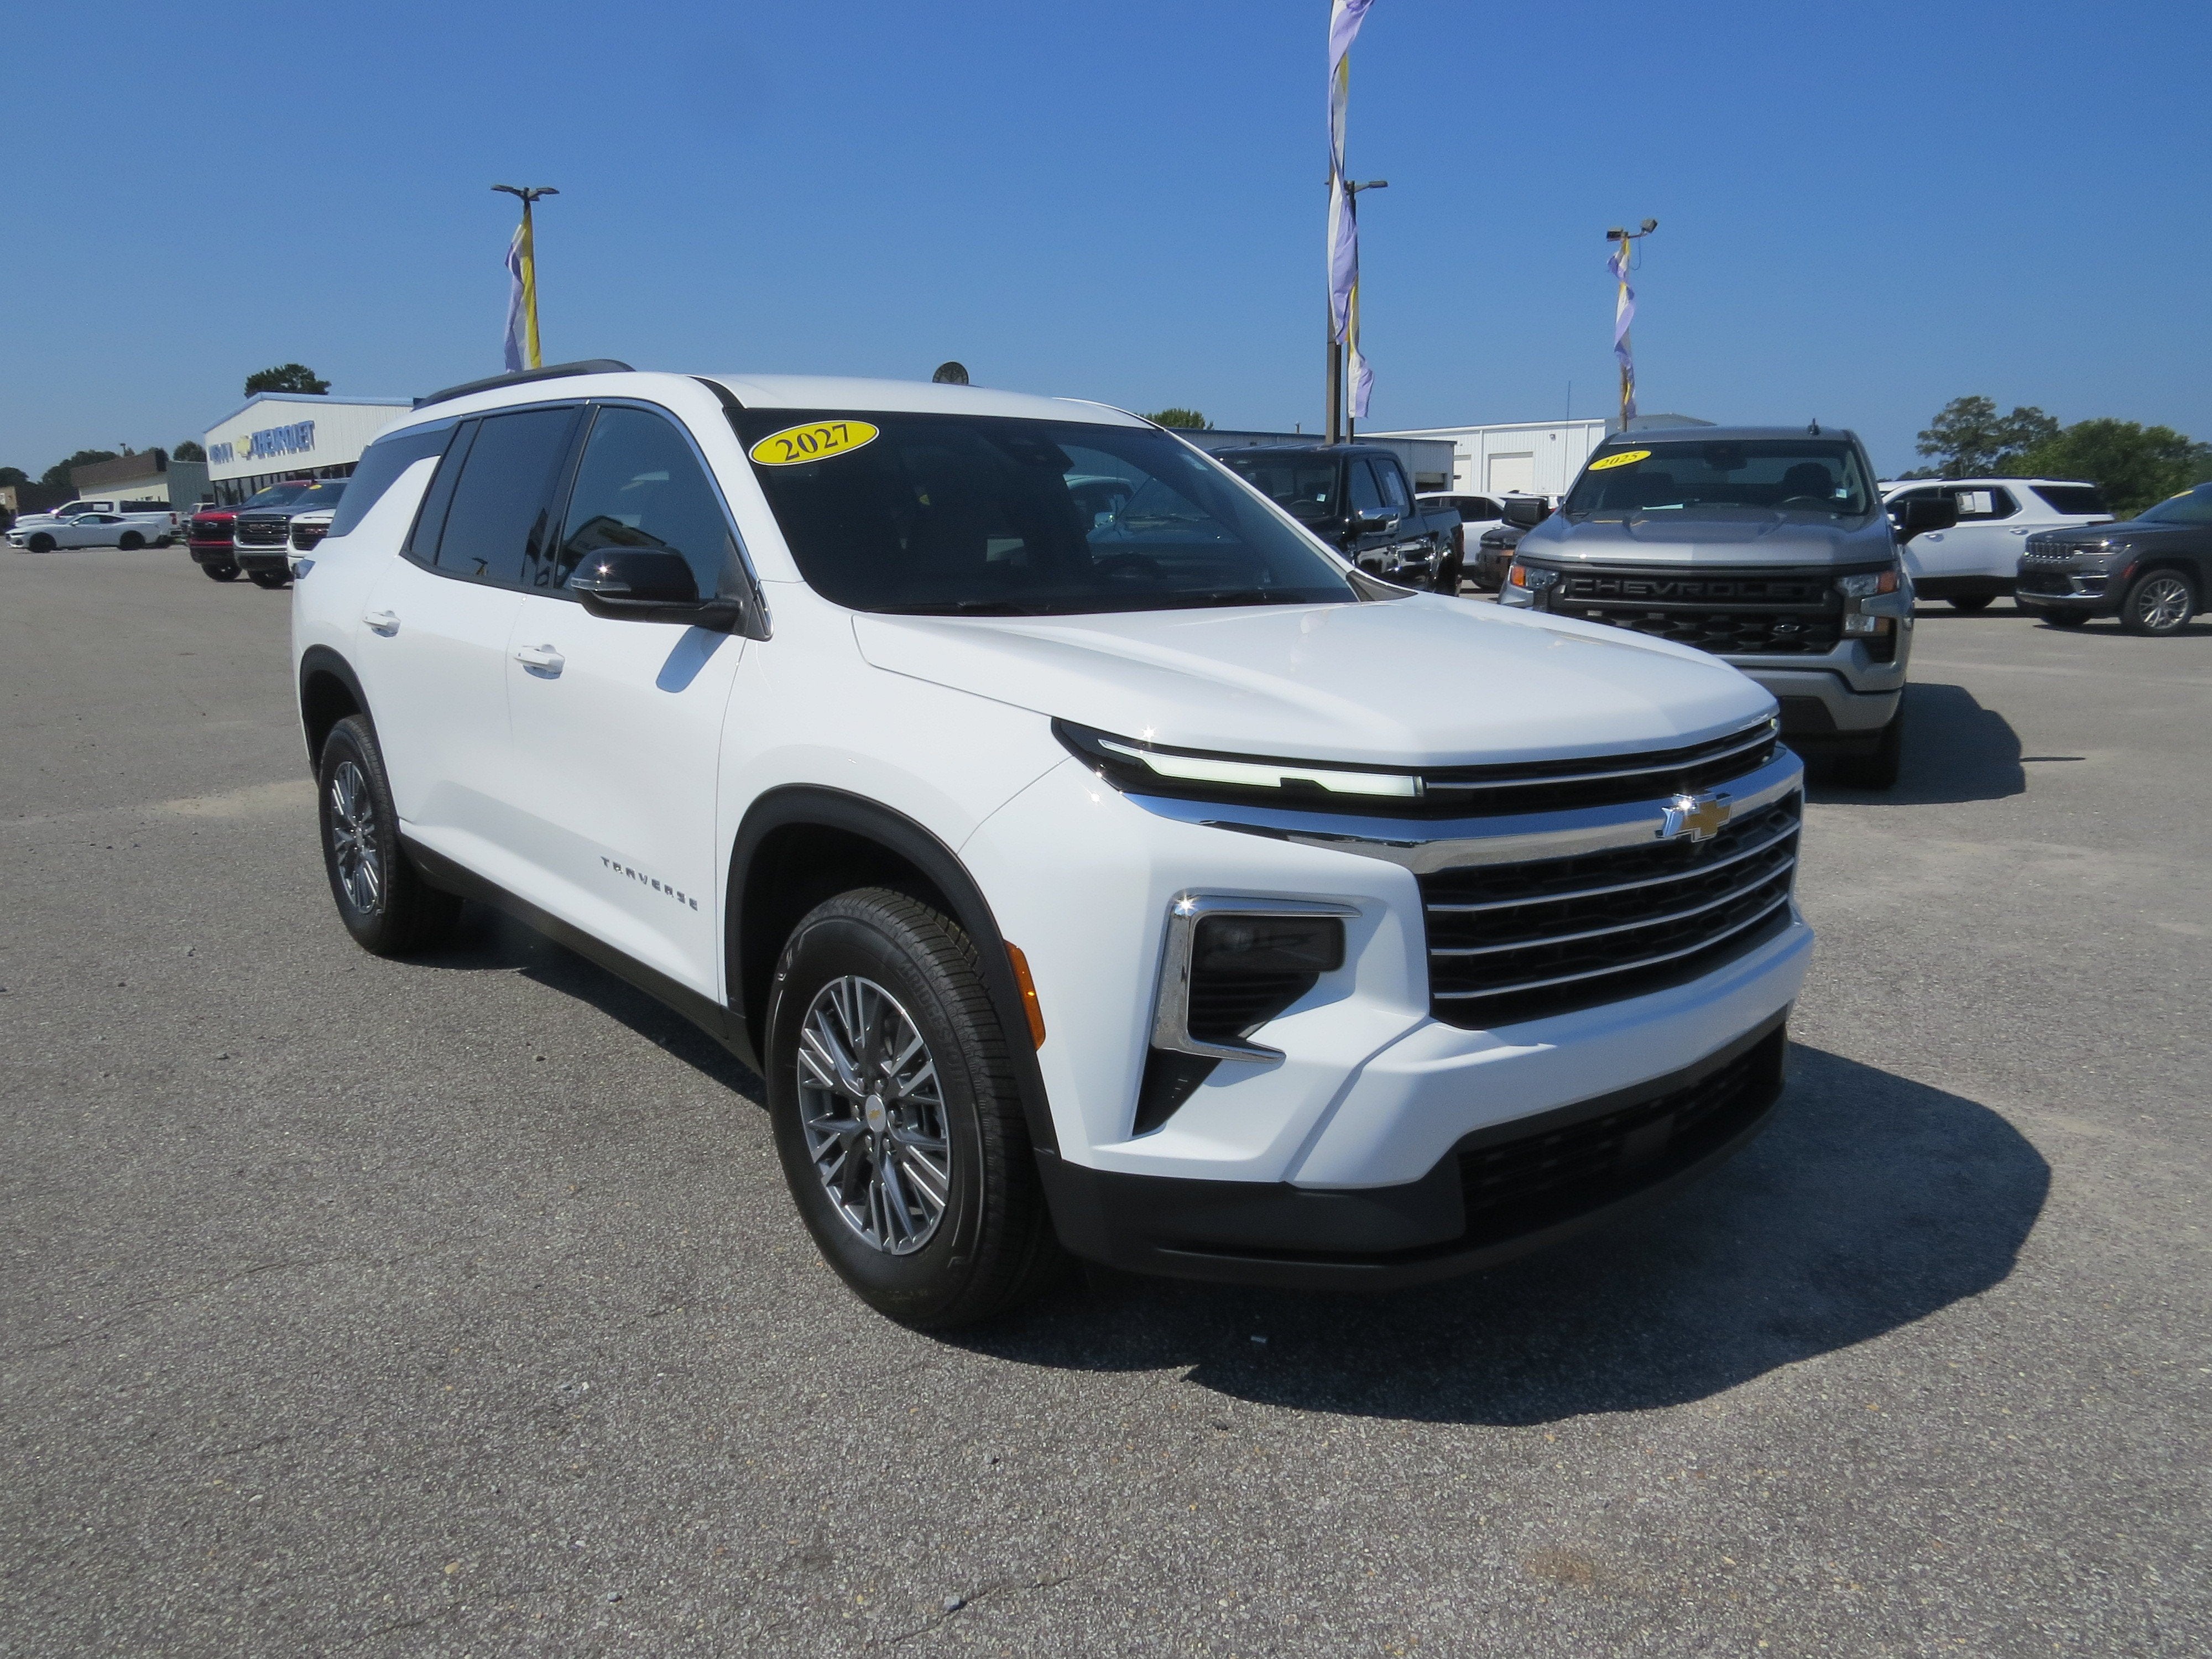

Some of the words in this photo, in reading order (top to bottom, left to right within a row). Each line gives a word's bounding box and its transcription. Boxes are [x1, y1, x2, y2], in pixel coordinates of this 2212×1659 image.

[775, 424, 848, 461] 2027
[1599, 452, 1640, 468] 2025
[1570, 577, 1818, 597] CHEVROLET
[601, 856, 698, 911] TRAVERSE
